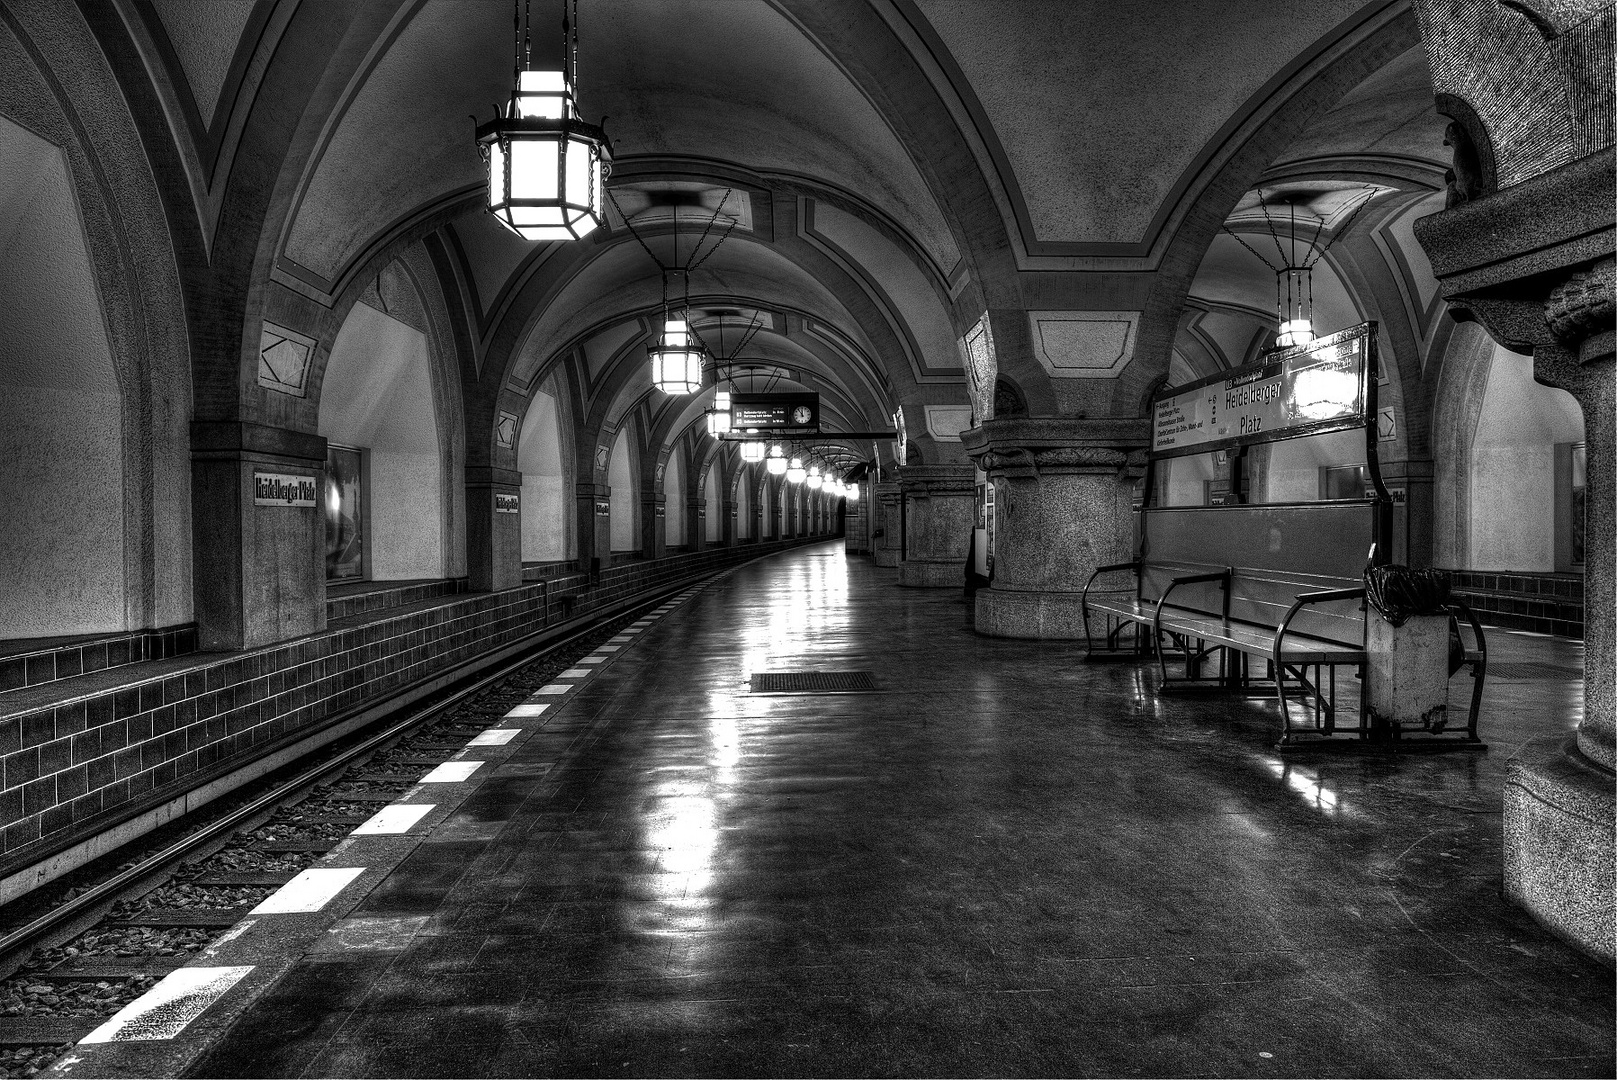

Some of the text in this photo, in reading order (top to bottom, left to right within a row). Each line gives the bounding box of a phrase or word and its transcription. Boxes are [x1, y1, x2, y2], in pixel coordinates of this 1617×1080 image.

[1225, 381, 1282, 410] Heidelberger
[1226, 379, 1233, 390] U3
[1240, 414, 1262, 435] Platz
[256, 478, 315, 503] Heidelberger Platz
